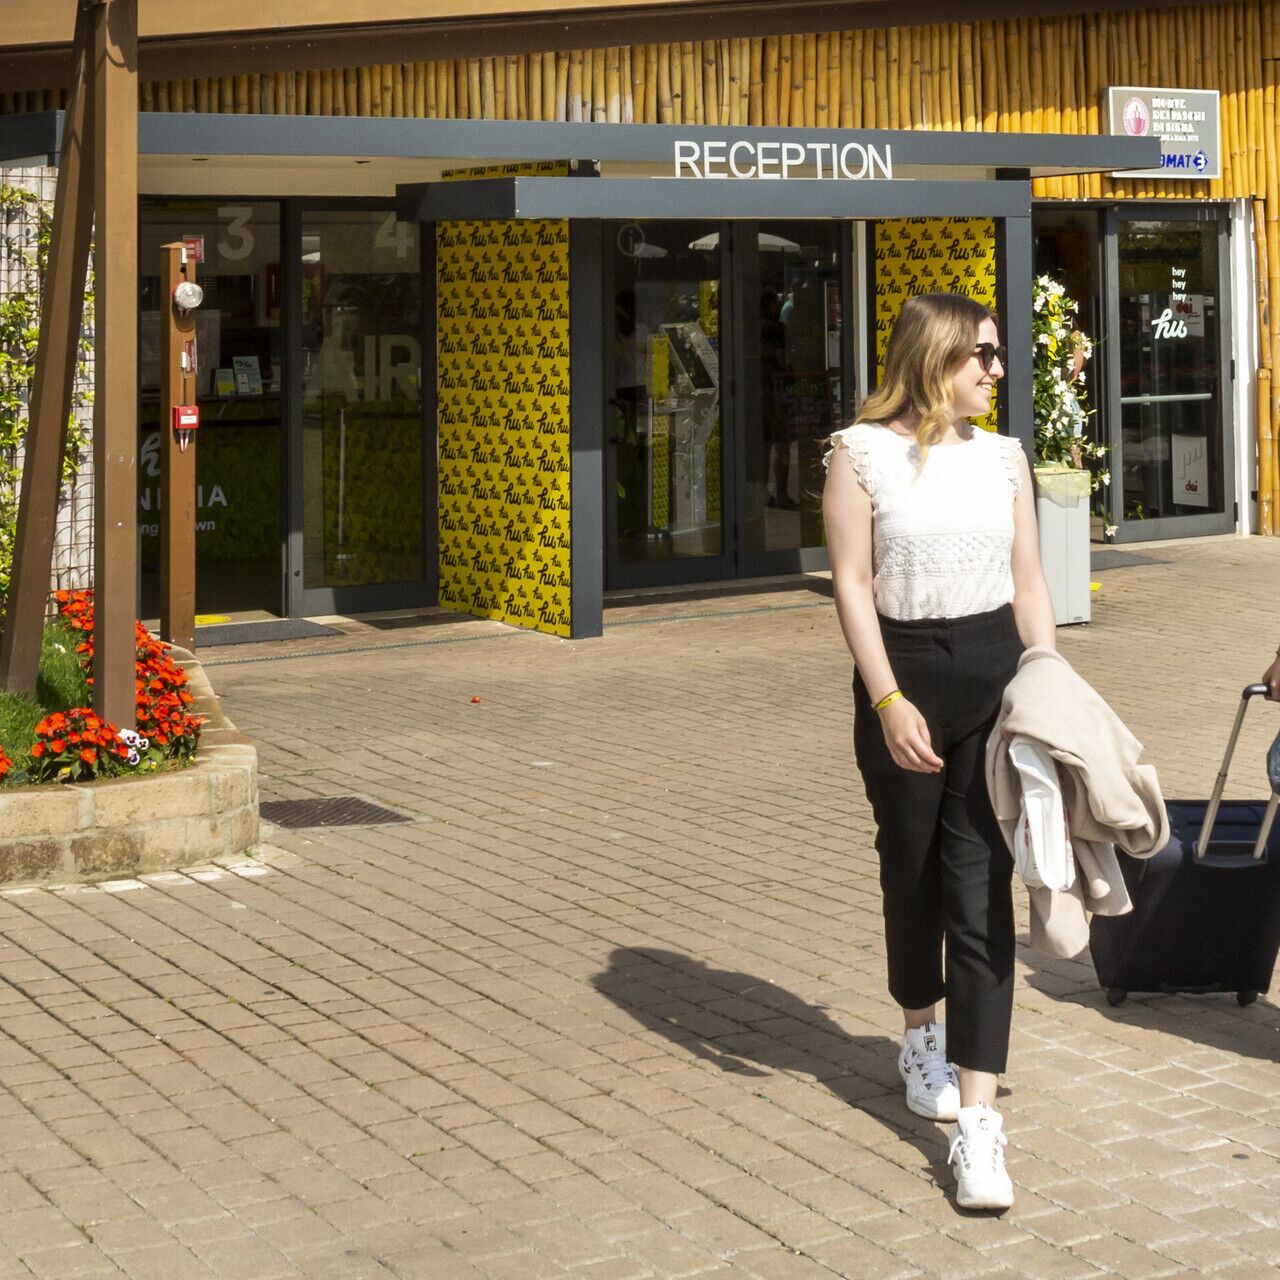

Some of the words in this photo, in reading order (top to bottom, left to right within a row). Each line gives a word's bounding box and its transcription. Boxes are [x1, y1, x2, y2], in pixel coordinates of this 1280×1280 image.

[674, 140, 894, 180] RECEPTION
[1172, 267, 1186, 278] hey
[1172, 279, 1186, 291] hey
[1173, 291, 1187, 303] hey
[1151, 308, 1187, 339] hu
